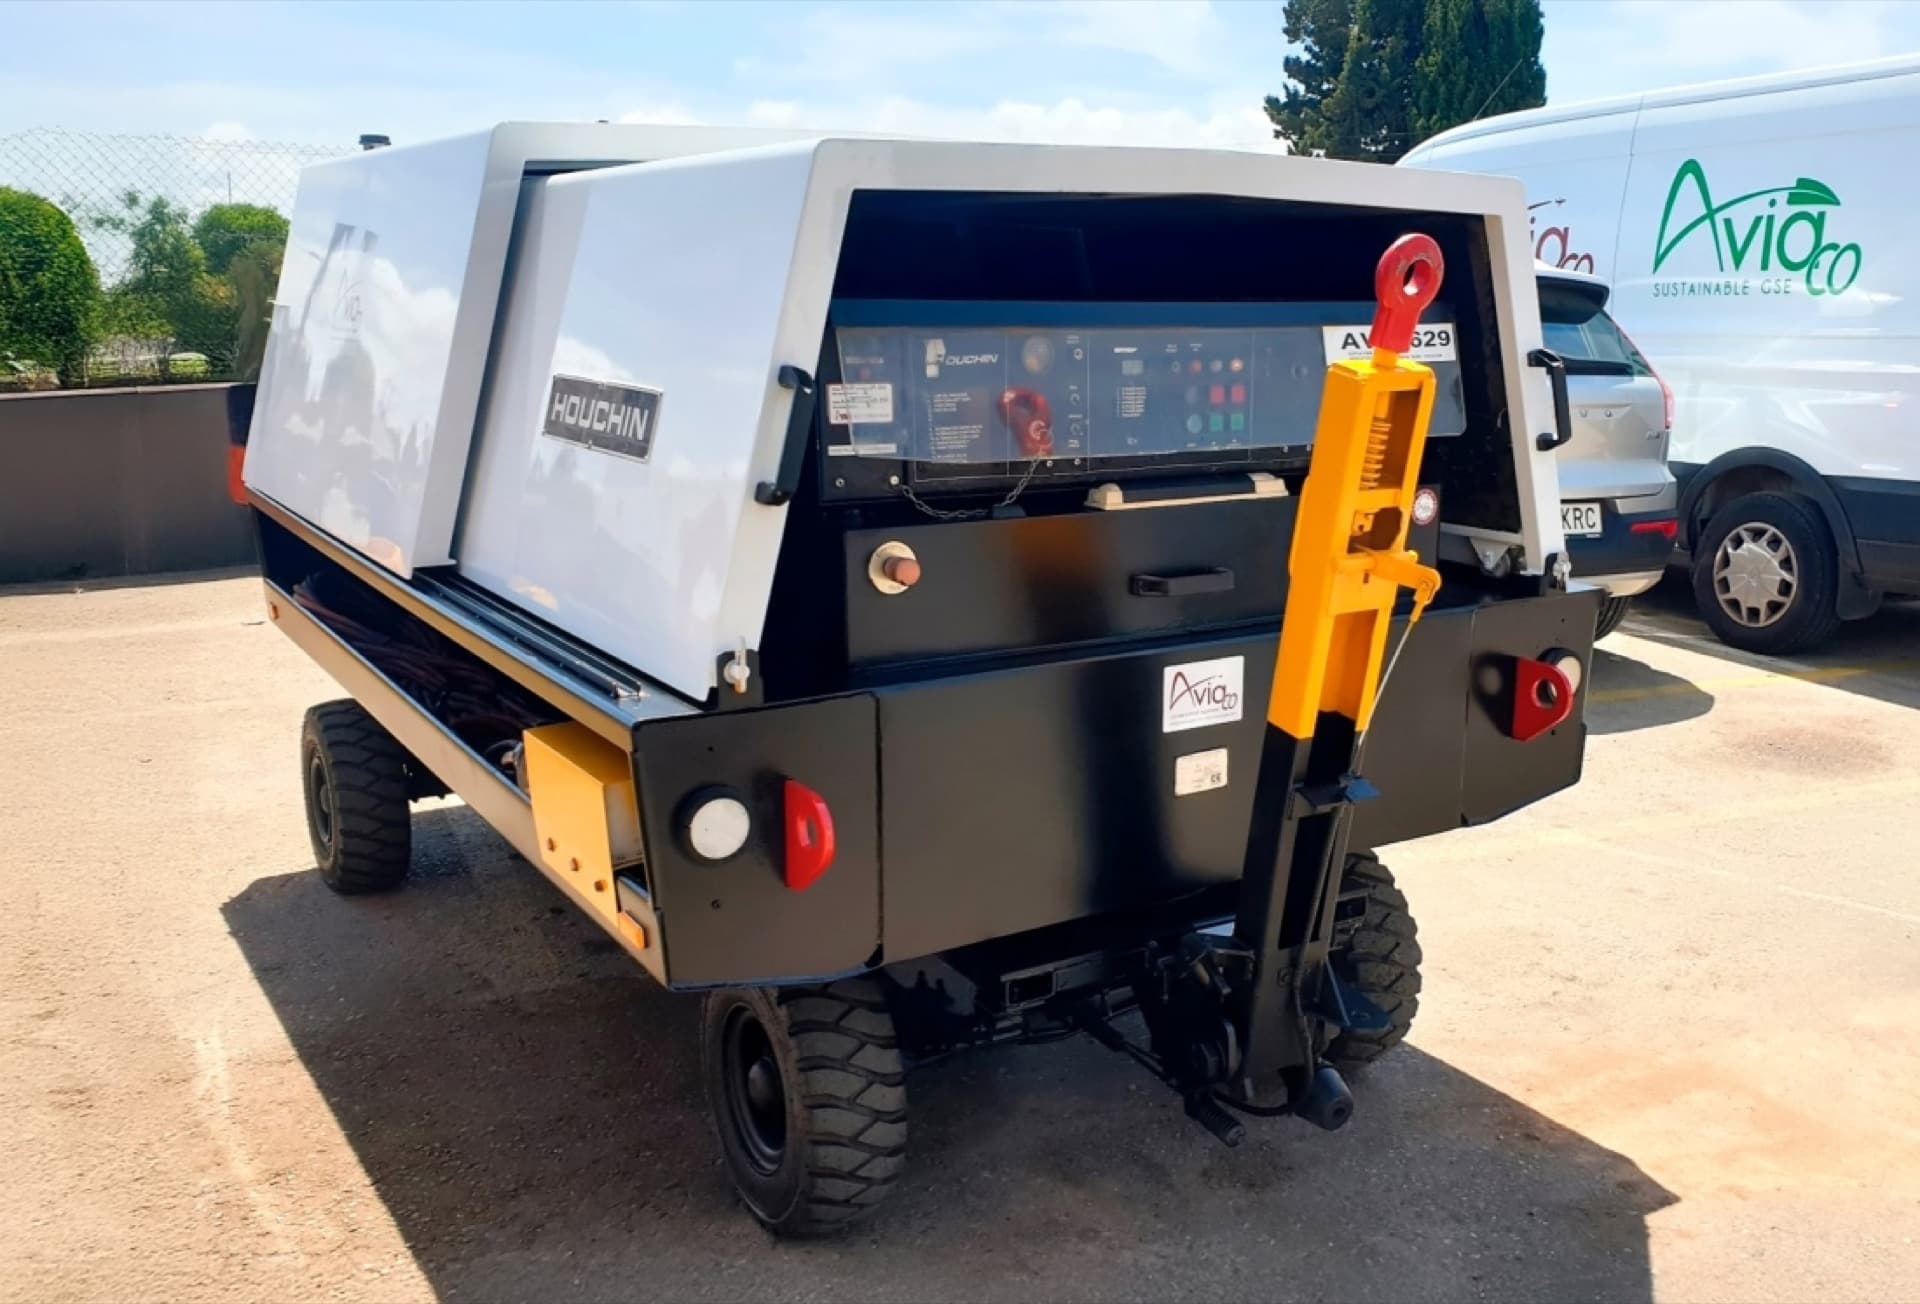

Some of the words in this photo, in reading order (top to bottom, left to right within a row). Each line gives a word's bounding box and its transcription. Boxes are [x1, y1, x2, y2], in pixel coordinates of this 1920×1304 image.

[1652, 158, 1862, 295] Aviaco
[1652, 280, 1750, 298] SUSTAINABLE
[1760, 278, 1792, 296] GSE
[551, 392, 649, 441] HOUCHIN
[1560, 507, 1596, 530] KRC
